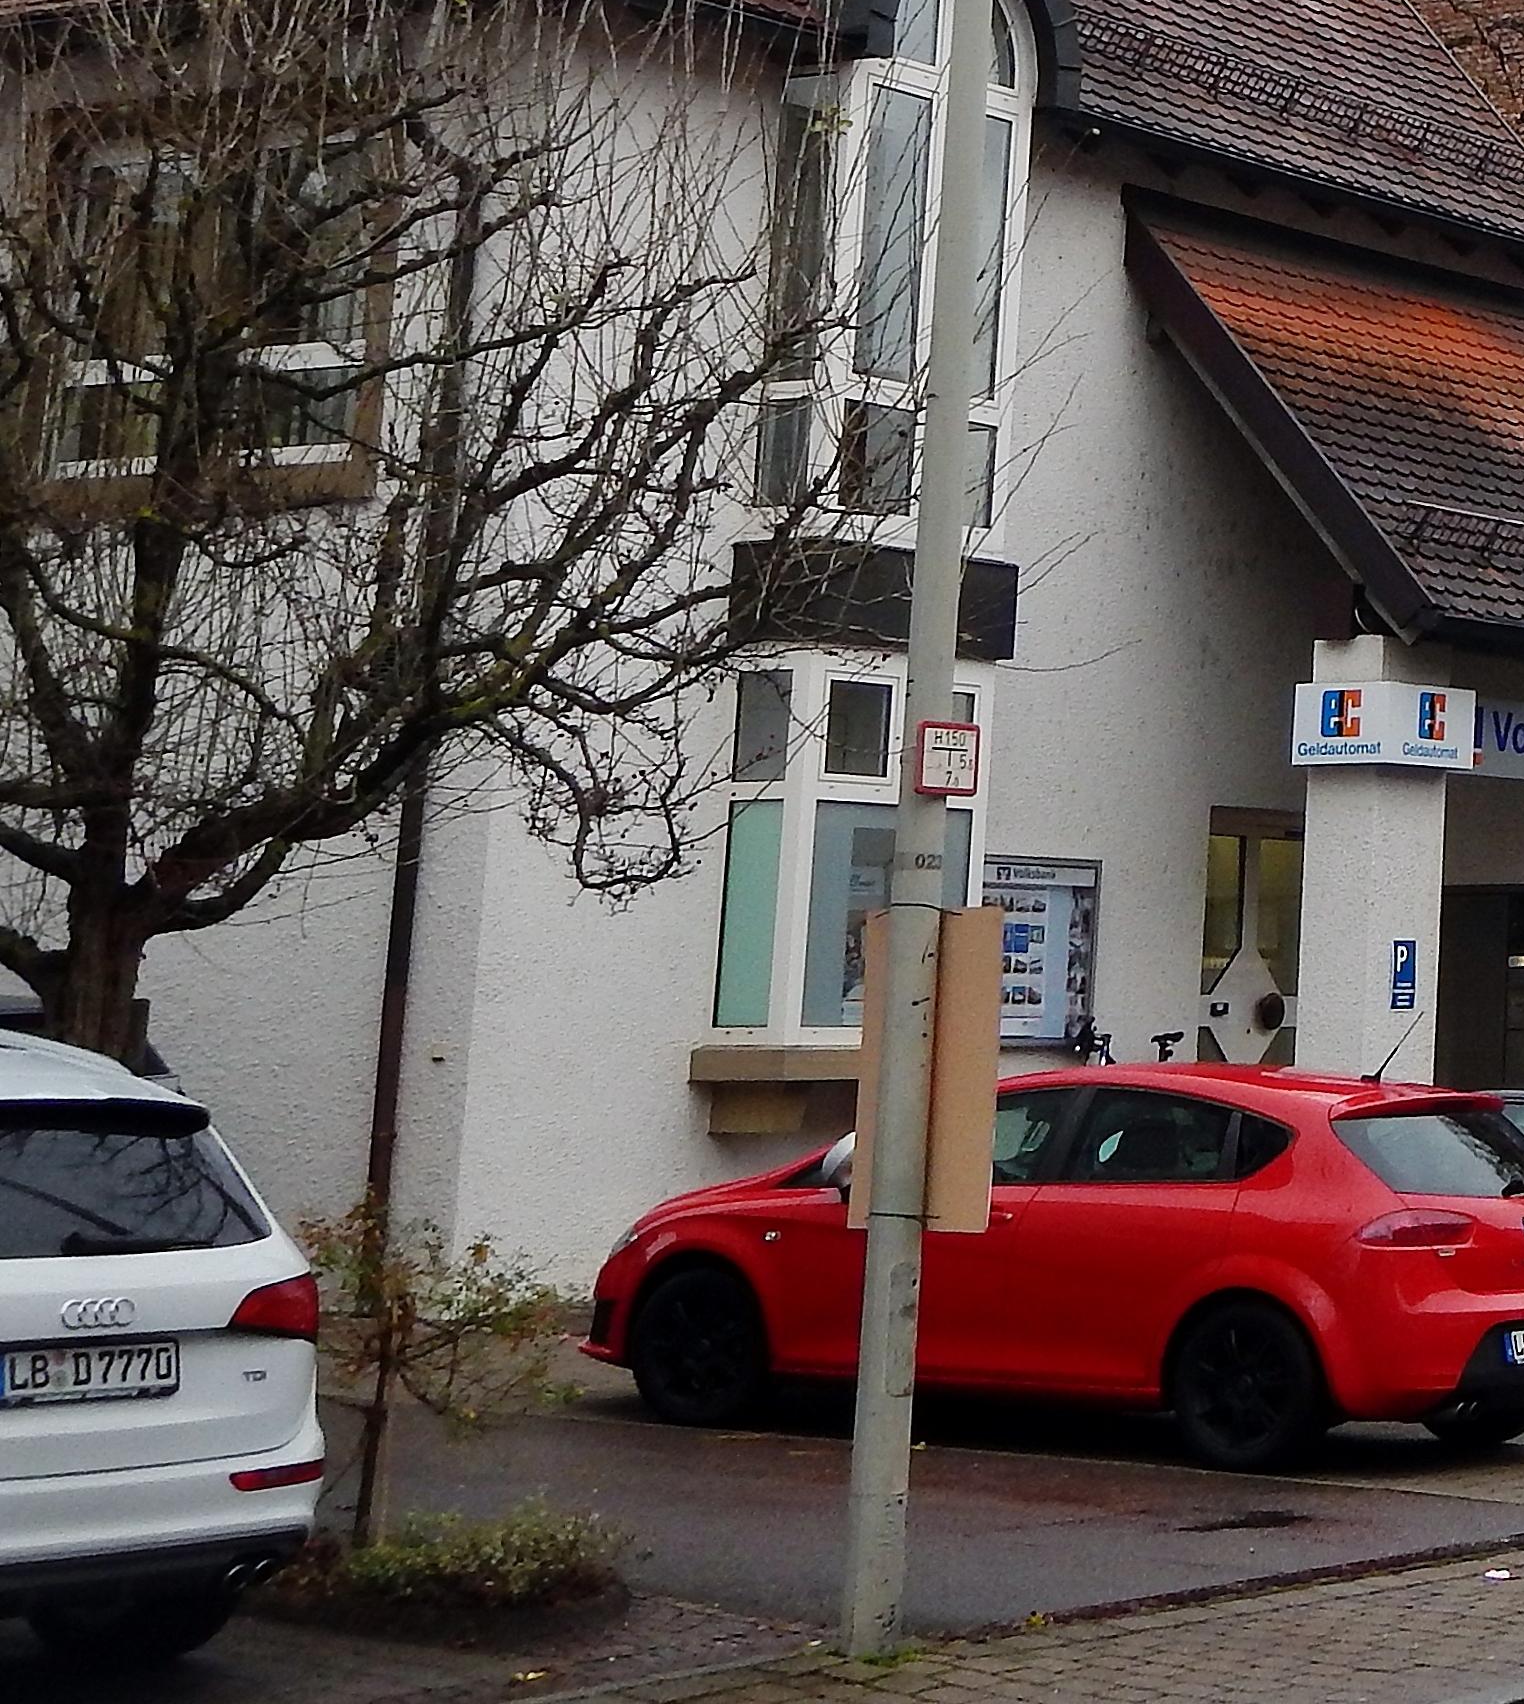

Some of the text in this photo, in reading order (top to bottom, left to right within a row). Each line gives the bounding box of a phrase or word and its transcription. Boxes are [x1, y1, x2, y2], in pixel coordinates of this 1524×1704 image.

[934, 730, 966, 747] H150
[1297, 742, 1381, 757] Geldautomat
[1402, 741, 1458, 759] Geldautomat
[1396, 945, 1408, 973] P
[9, 1354, 50, 1390] LB
